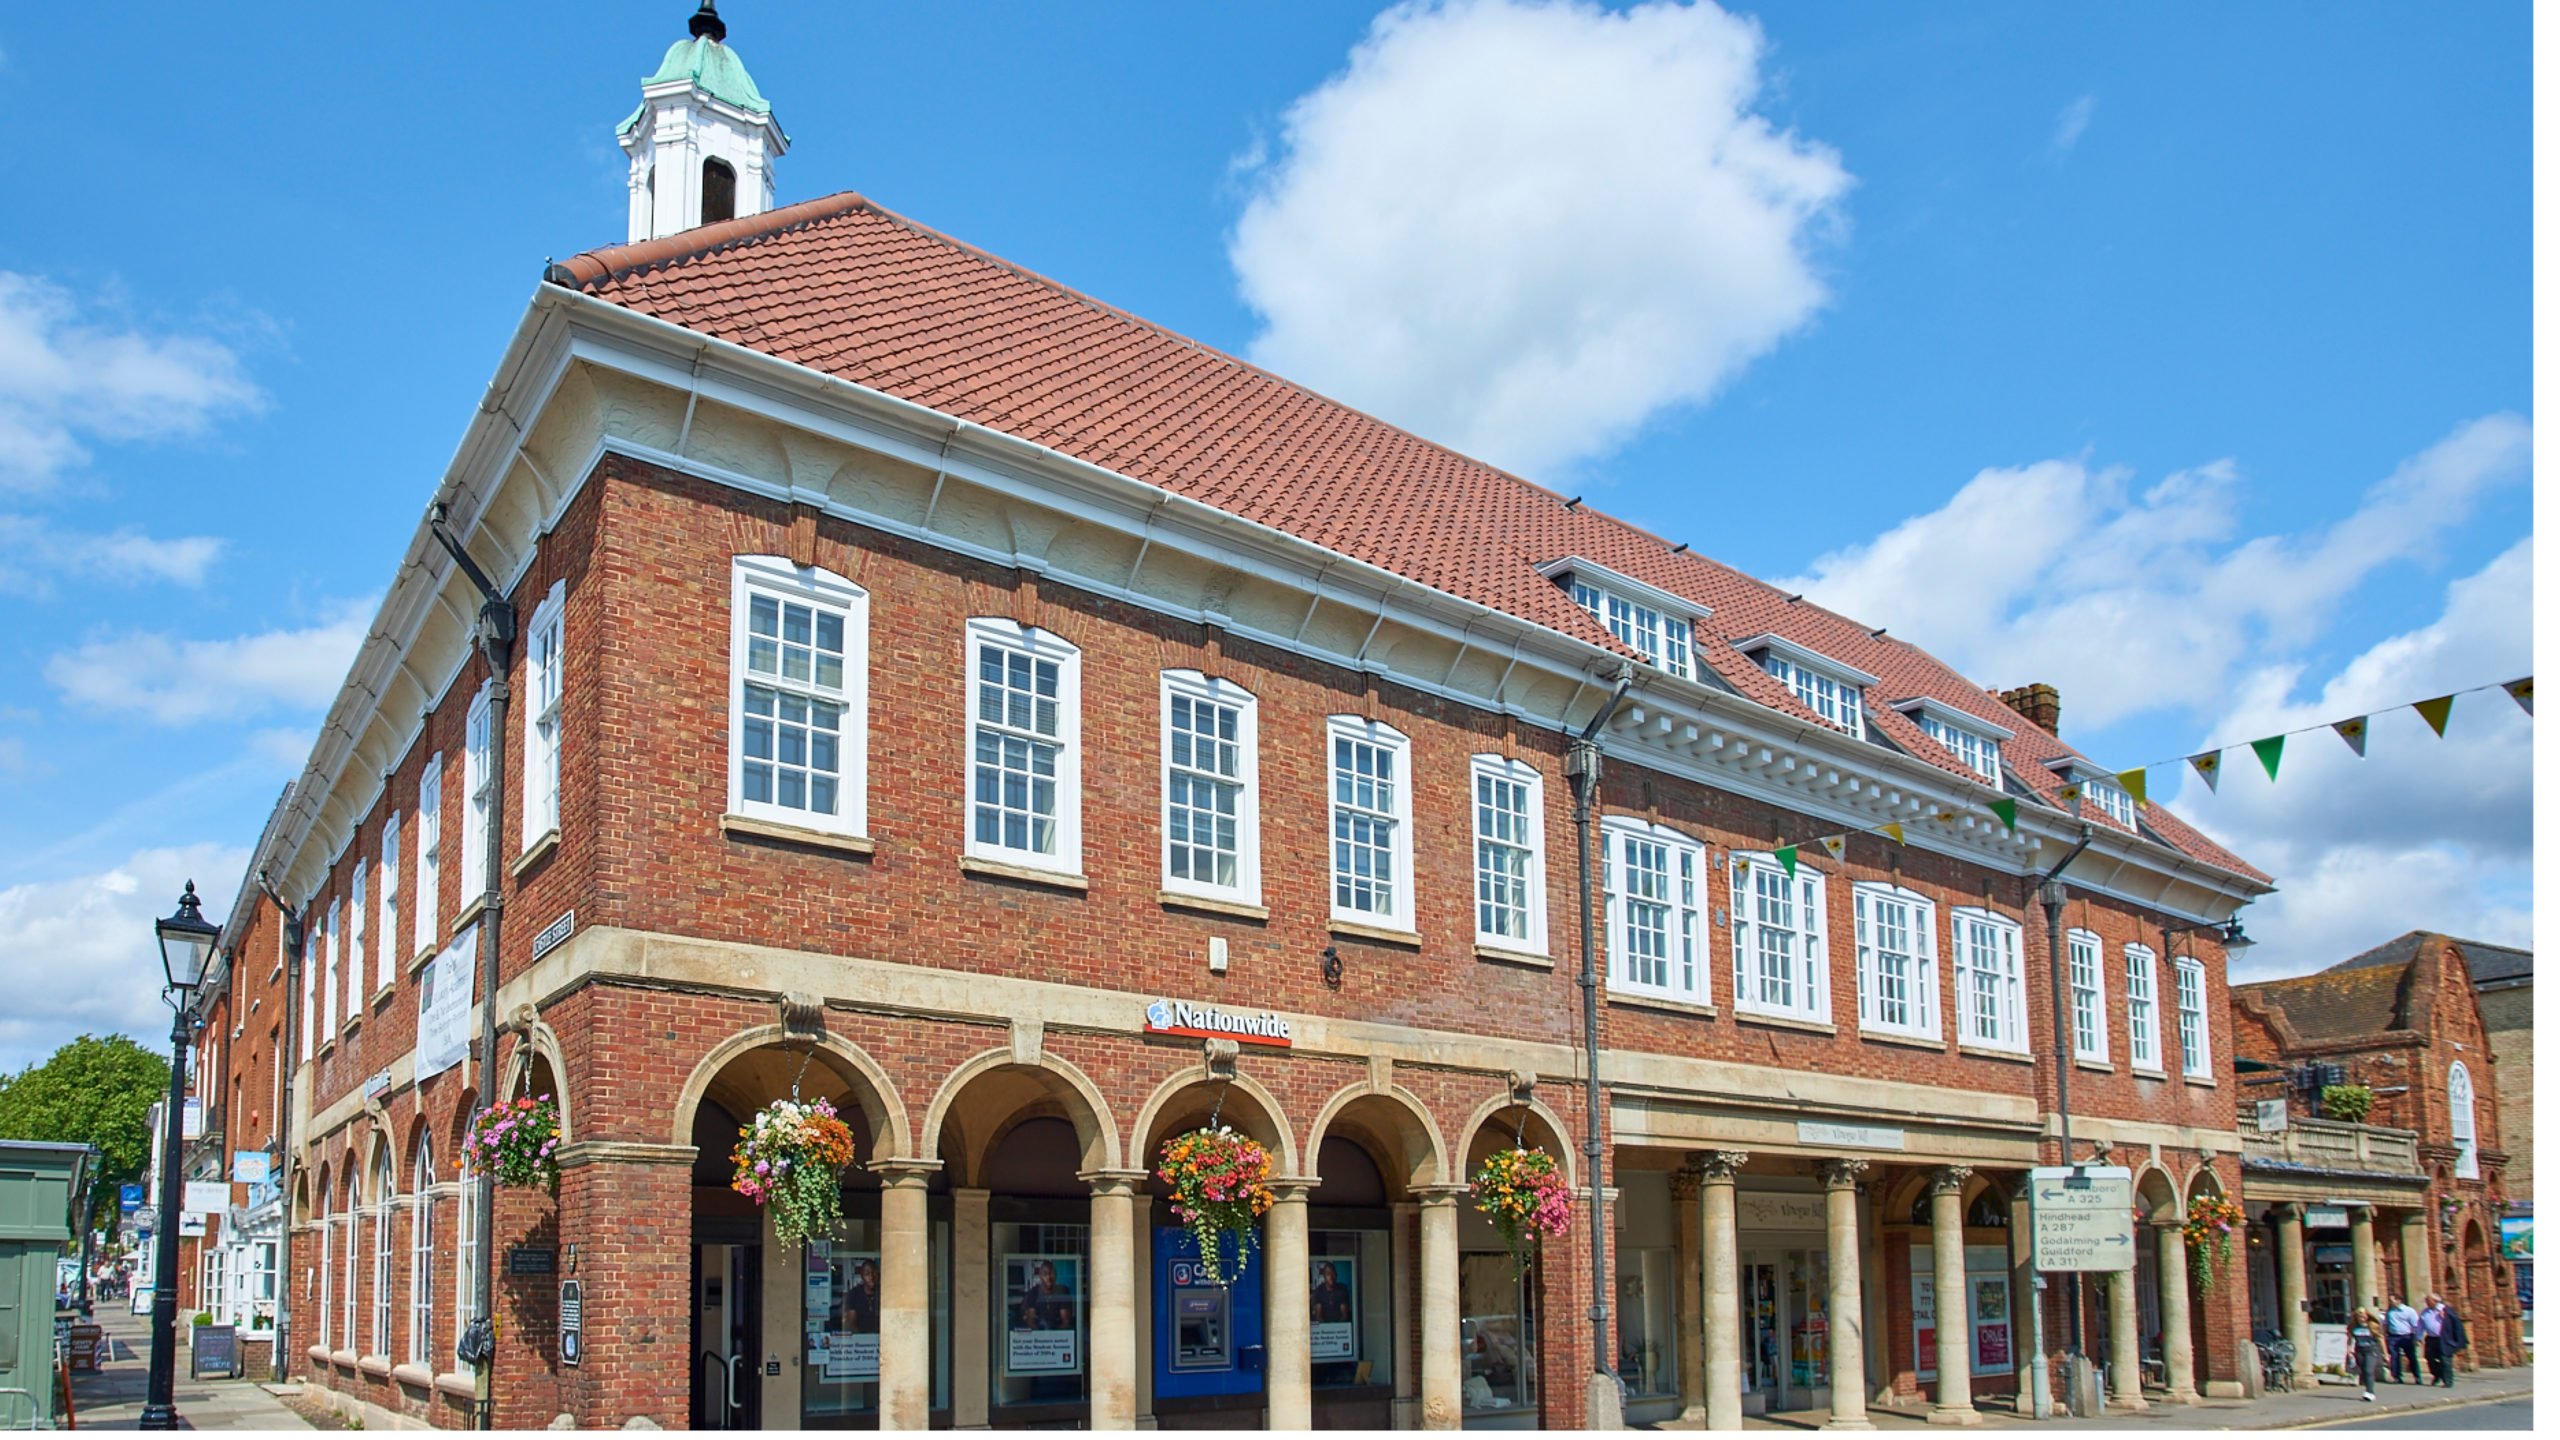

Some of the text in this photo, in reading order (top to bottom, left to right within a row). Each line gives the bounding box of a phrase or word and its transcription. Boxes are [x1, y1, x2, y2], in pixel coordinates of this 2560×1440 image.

[1174, 1001, 1290, 1038] Nationwide
[2068, 1195, 2102, 1204] A 325
[2040, 1212, 2091, 1221] Hindhead
[2041, 1223, 2074, 1232] A 287
[2040, 1236, 2100, 1247] Godalming
[2040, 1247, 2093, 1257] Guildford
[1914, 1310, 1930, 1320] ETAIL
